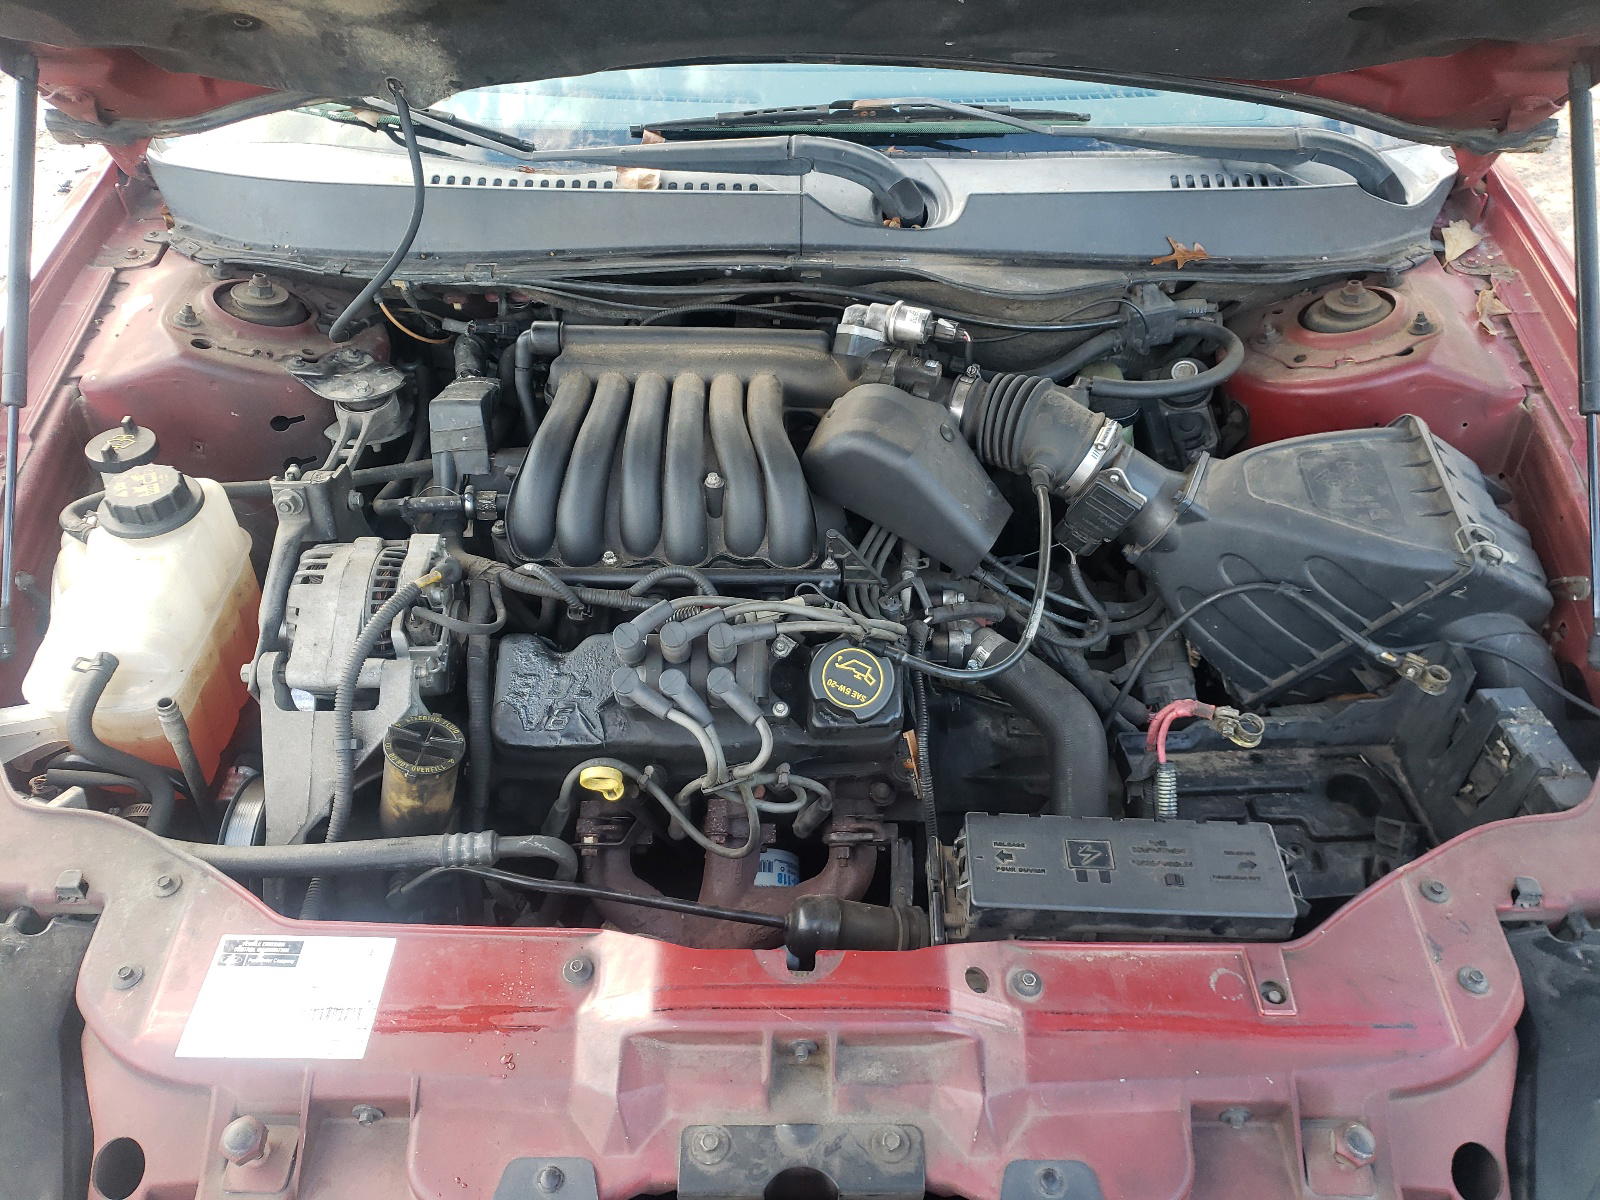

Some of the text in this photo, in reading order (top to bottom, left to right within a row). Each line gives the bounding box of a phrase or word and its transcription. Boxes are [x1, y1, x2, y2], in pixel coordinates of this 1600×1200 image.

[826, 679, 867, 702] SAE 5W-20
[442, 720, 460, 734] FLUID
